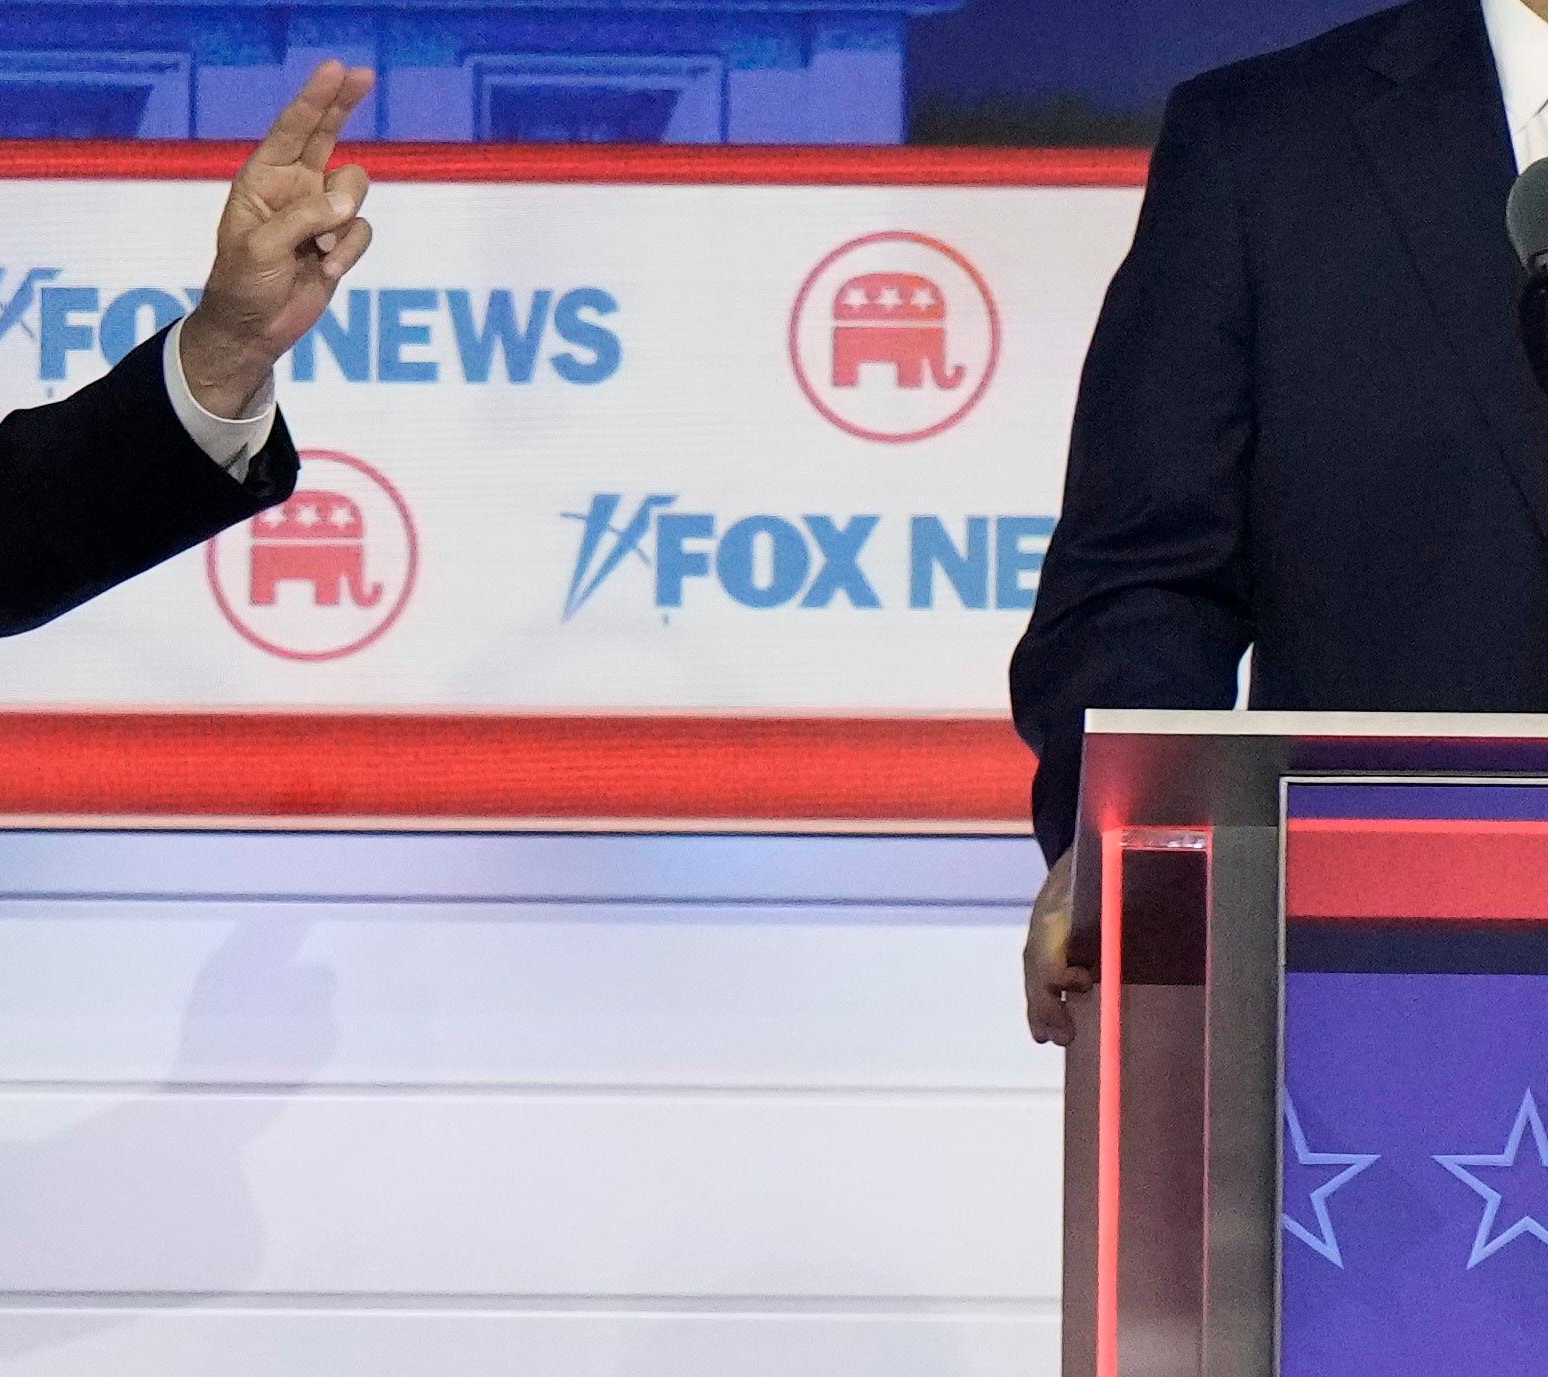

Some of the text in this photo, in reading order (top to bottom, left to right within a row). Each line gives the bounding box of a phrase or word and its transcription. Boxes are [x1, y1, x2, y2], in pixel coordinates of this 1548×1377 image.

[40, 287, 623, 384] FO NEWS
[656, 514, 1055, 610] FOX NE
